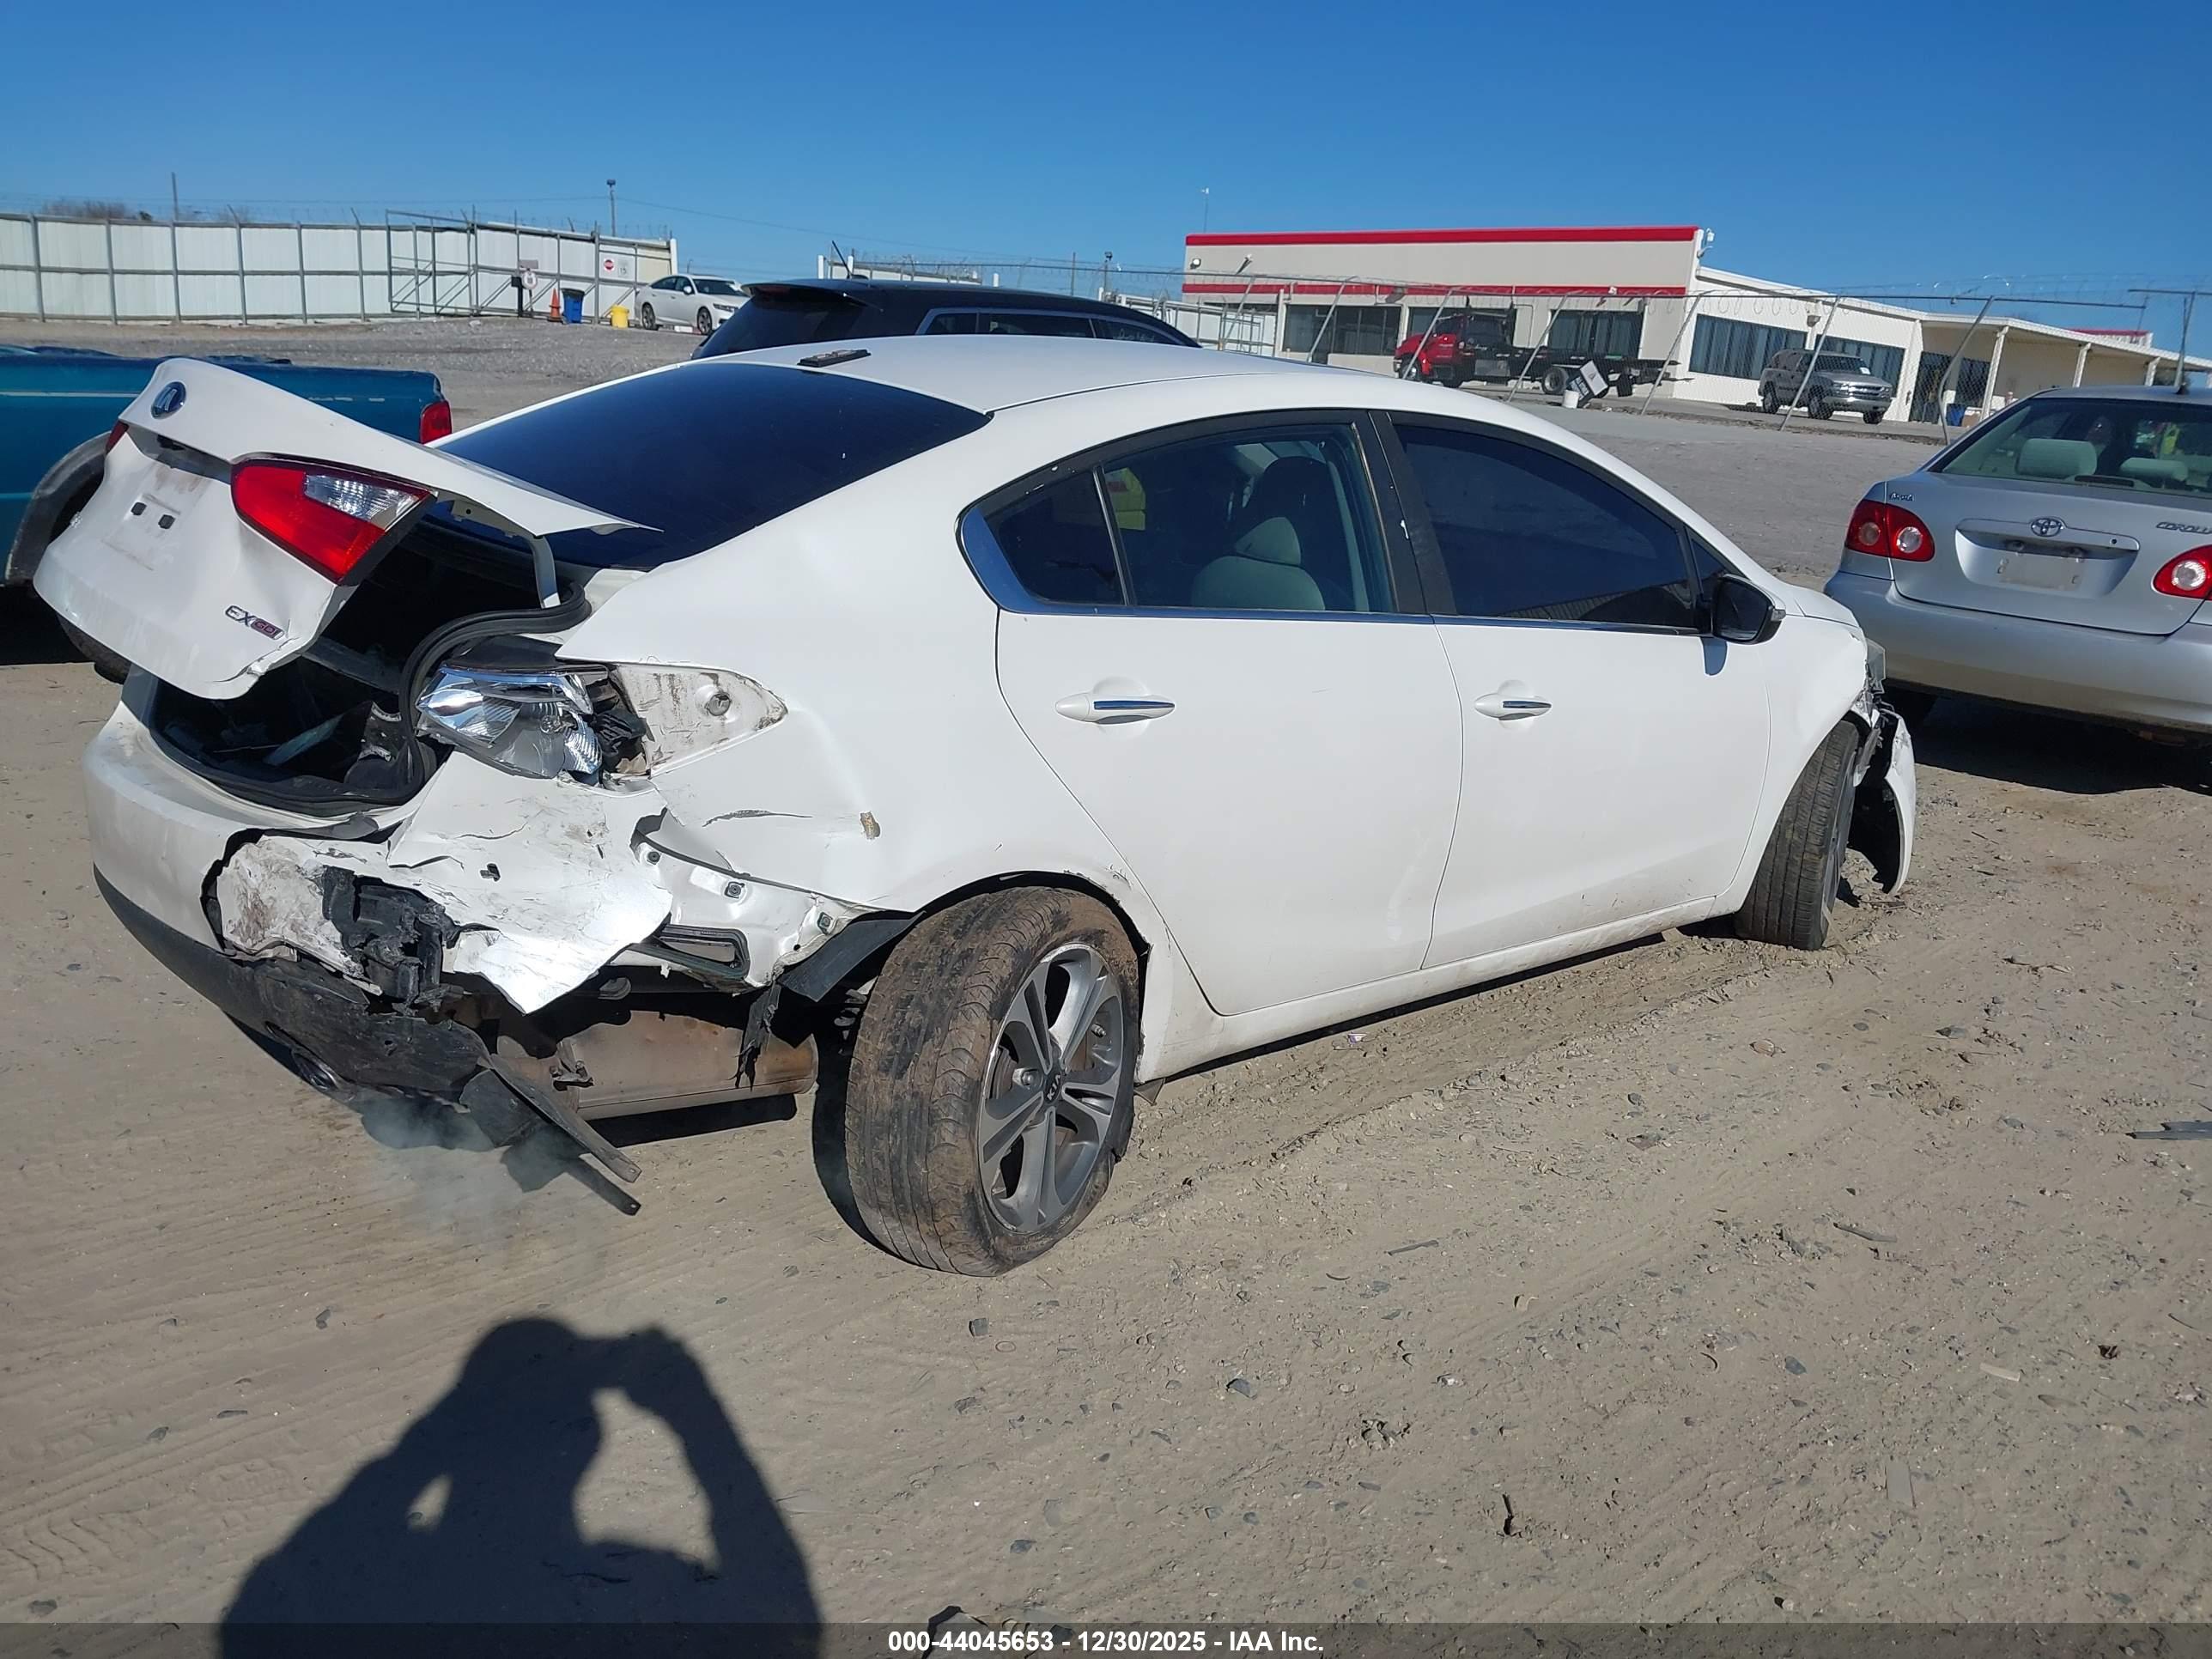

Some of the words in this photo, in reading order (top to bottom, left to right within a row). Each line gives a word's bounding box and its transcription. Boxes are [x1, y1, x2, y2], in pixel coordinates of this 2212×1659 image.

[2155, 521, 2212, 535] COROLL
[225, 605, 257, 627] EX
[1047, 1074, 1061, 1101] KIA
